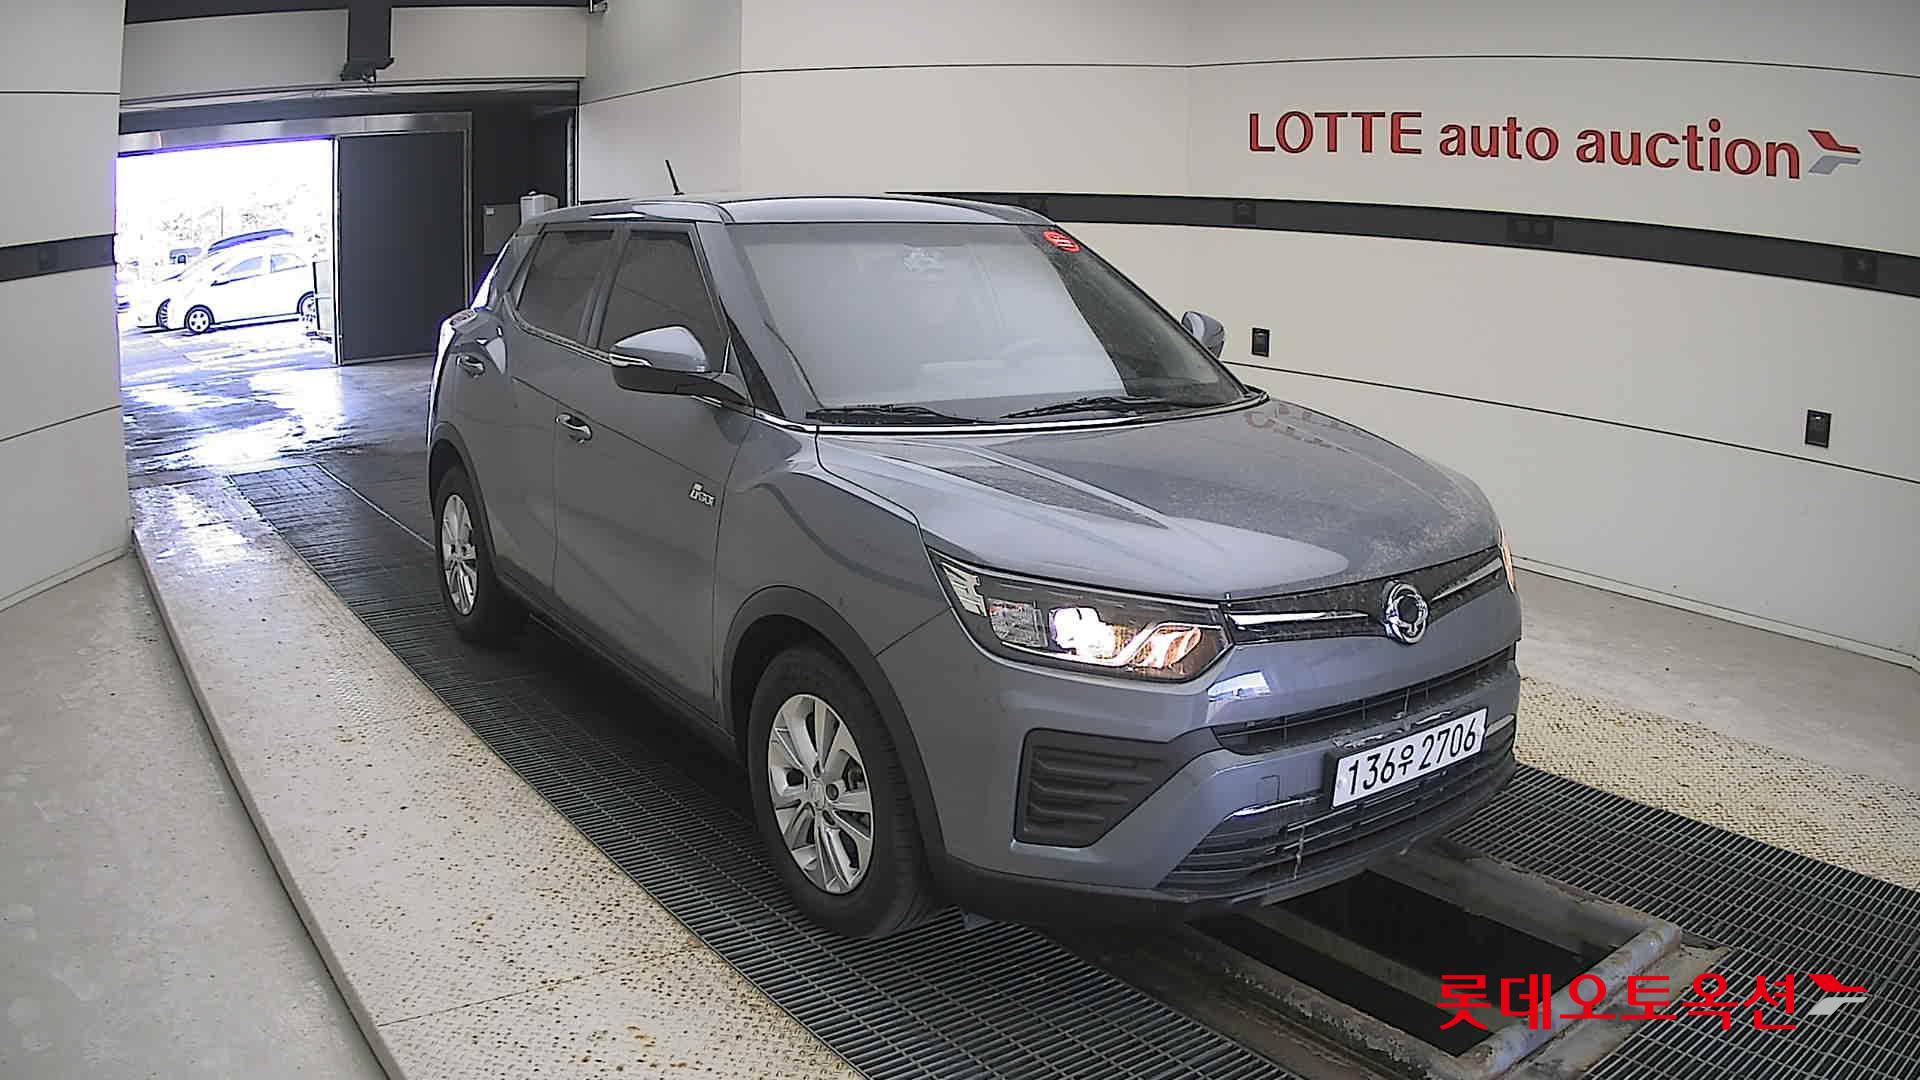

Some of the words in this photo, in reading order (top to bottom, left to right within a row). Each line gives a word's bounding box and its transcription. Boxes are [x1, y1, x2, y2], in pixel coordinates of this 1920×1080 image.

[1249, 112, 1422, 154] LOTTE
[1439, 117, 1559, 160] auto
[1575, 119, 1801, 179] auction
[1348, 744, 1415, 796] 136우
[1418, 718, 1476, 770] 2706
